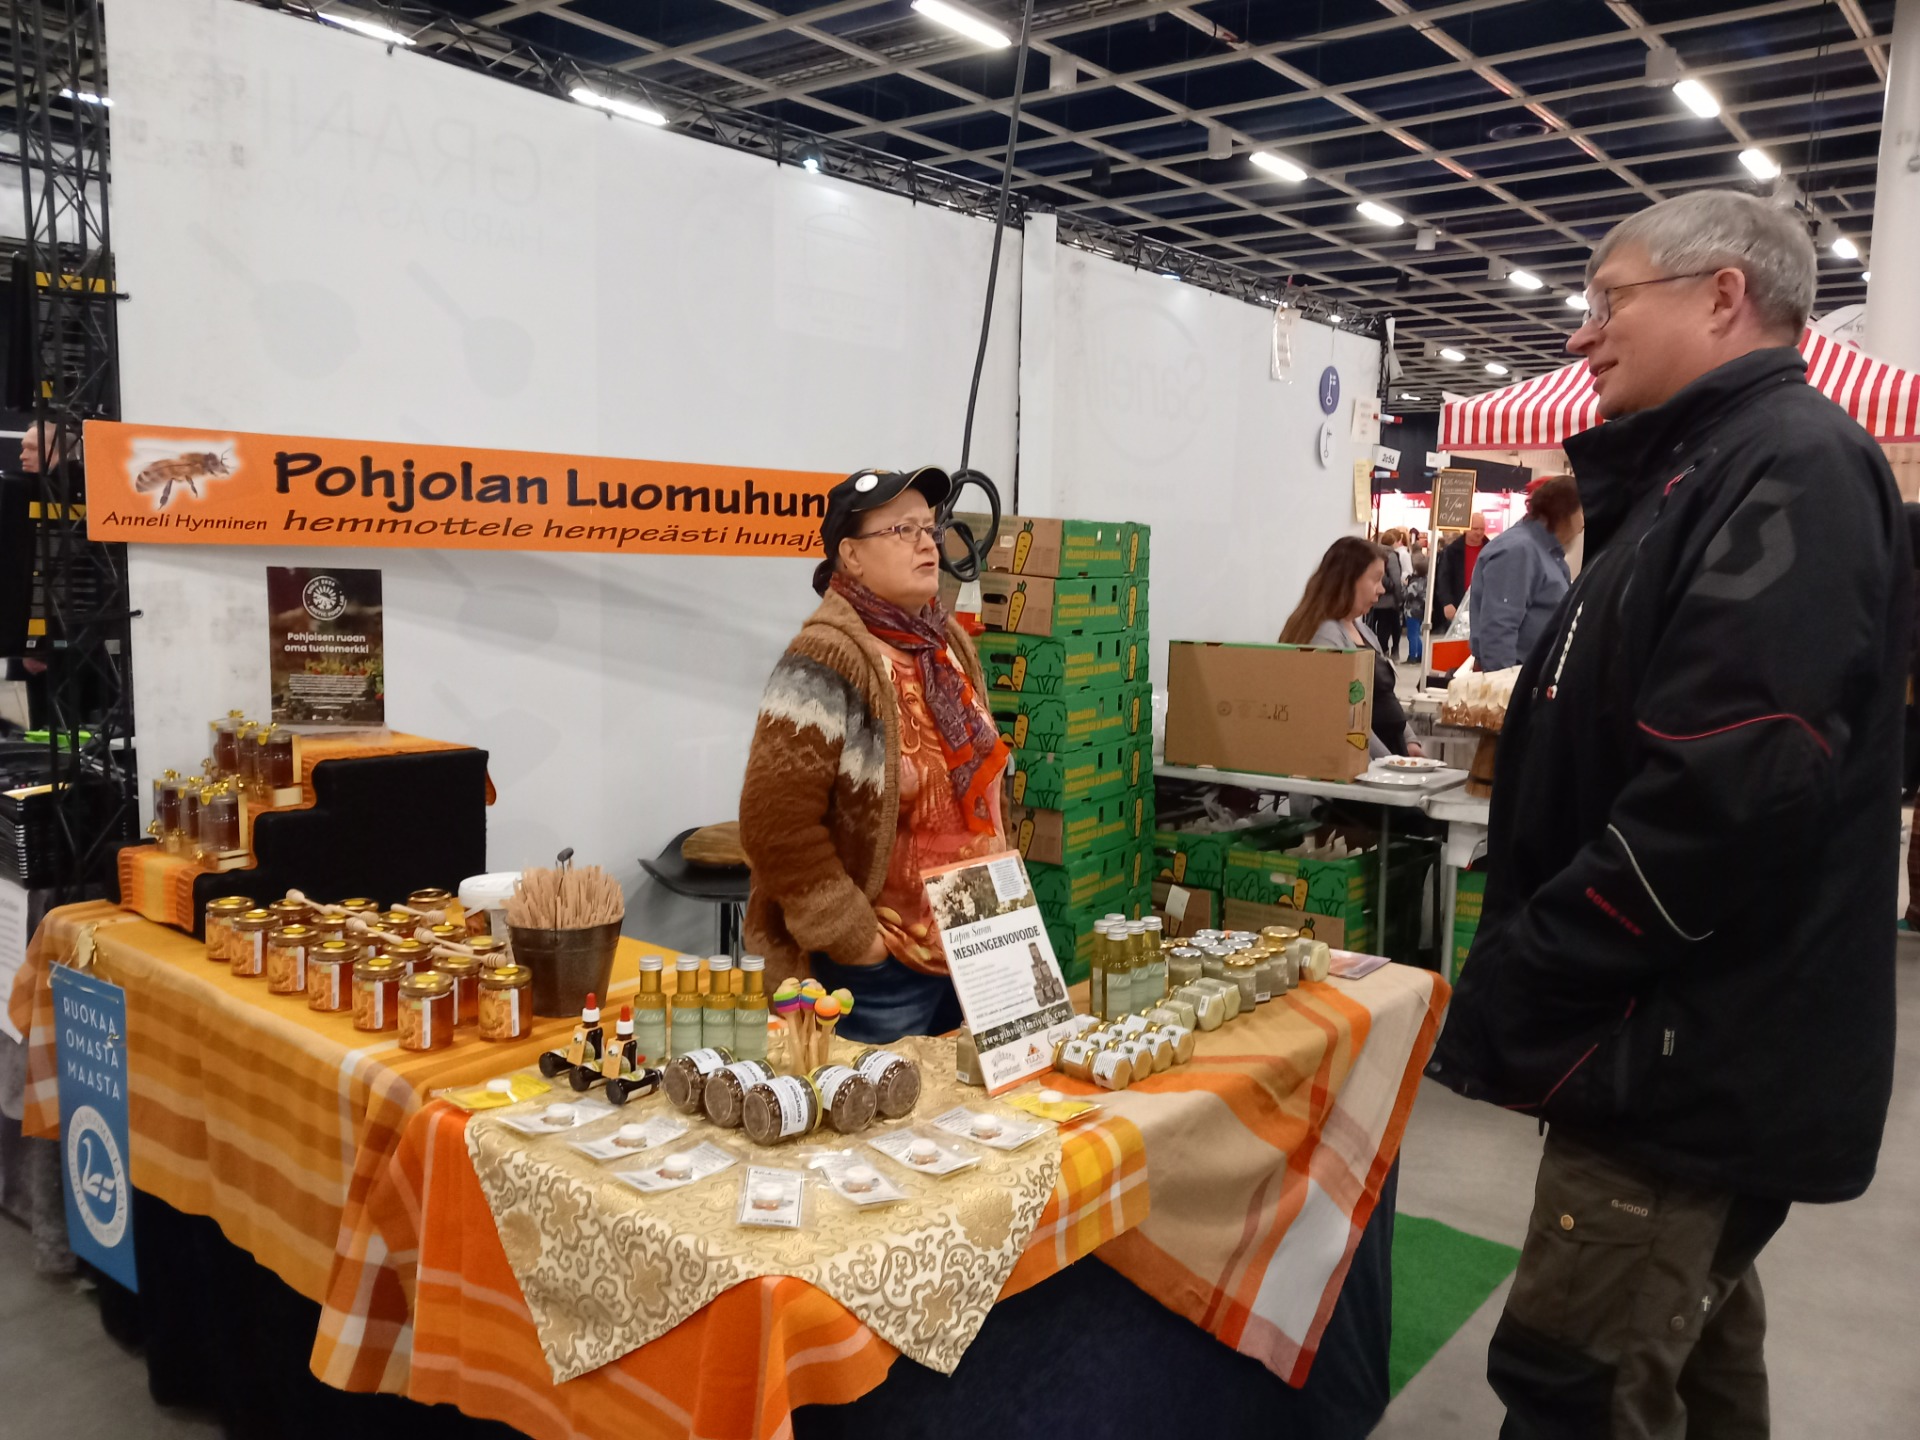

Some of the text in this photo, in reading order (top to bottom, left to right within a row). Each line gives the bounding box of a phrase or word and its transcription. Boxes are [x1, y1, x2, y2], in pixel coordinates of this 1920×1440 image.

[274, 451, 826, 518] Pohjolan Luomuhun
[102, 511, 268, 532] Anneli Hynninen
[283, 509, 825, 552] hemmottele hempeästi hunaja
[284, 643, 369, 654] oma tuotemerkki
[287, 632, 366, 643] Pohjoisen ruoan
[952, 925, 1041, 961] MESIANGERVOVOIDE
[63, 997, 117, 1034] RUOKAA
[66, 1029, 120, 1068] OMASTA
[67, 1061, 120, 1100] MAASTA
[1611, 1199, 1649, 1217] G-1000
